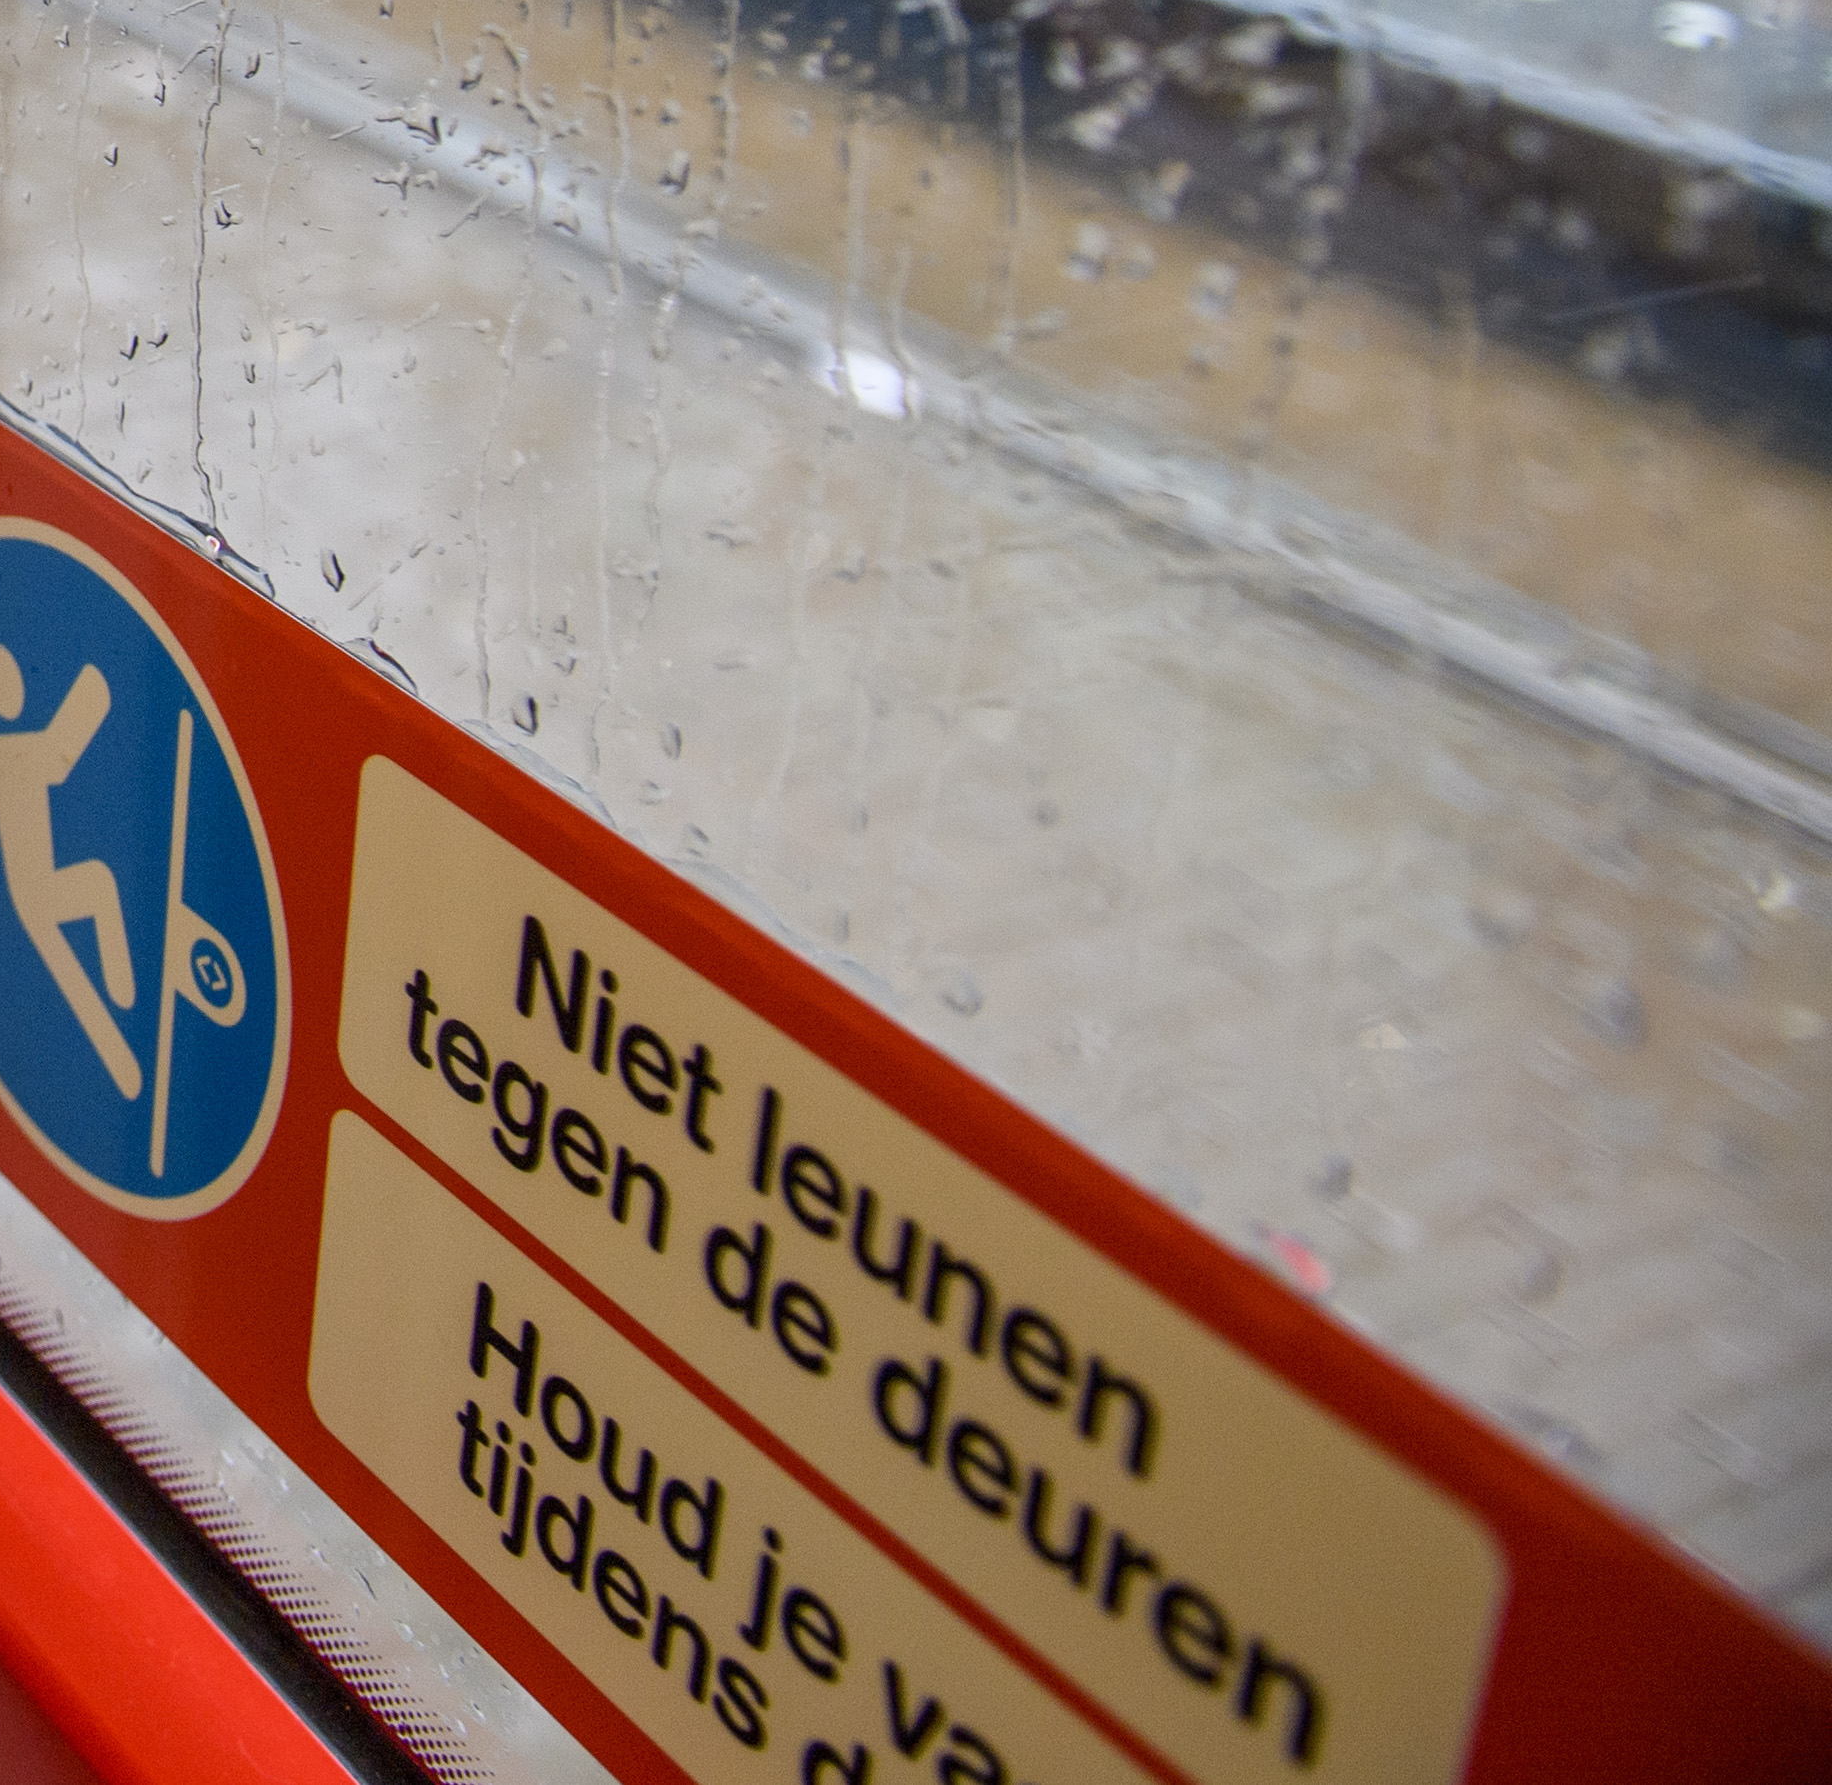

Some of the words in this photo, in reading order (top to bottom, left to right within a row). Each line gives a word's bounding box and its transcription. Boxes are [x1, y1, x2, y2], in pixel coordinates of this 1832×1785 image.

[405, 968, 671, 1255] tegen
[703, 1223, 838, 1377] de
[871, 1357, 1327, 1772] deuren
[515, 915, 722, 1155] Niet
[751, 1086, 1162, 1483] leunen
[456, 1399, 770, 1750] tijdens
[468, 1281, 725, 1582] Houd
[739, 1526, 848, 1684] je
